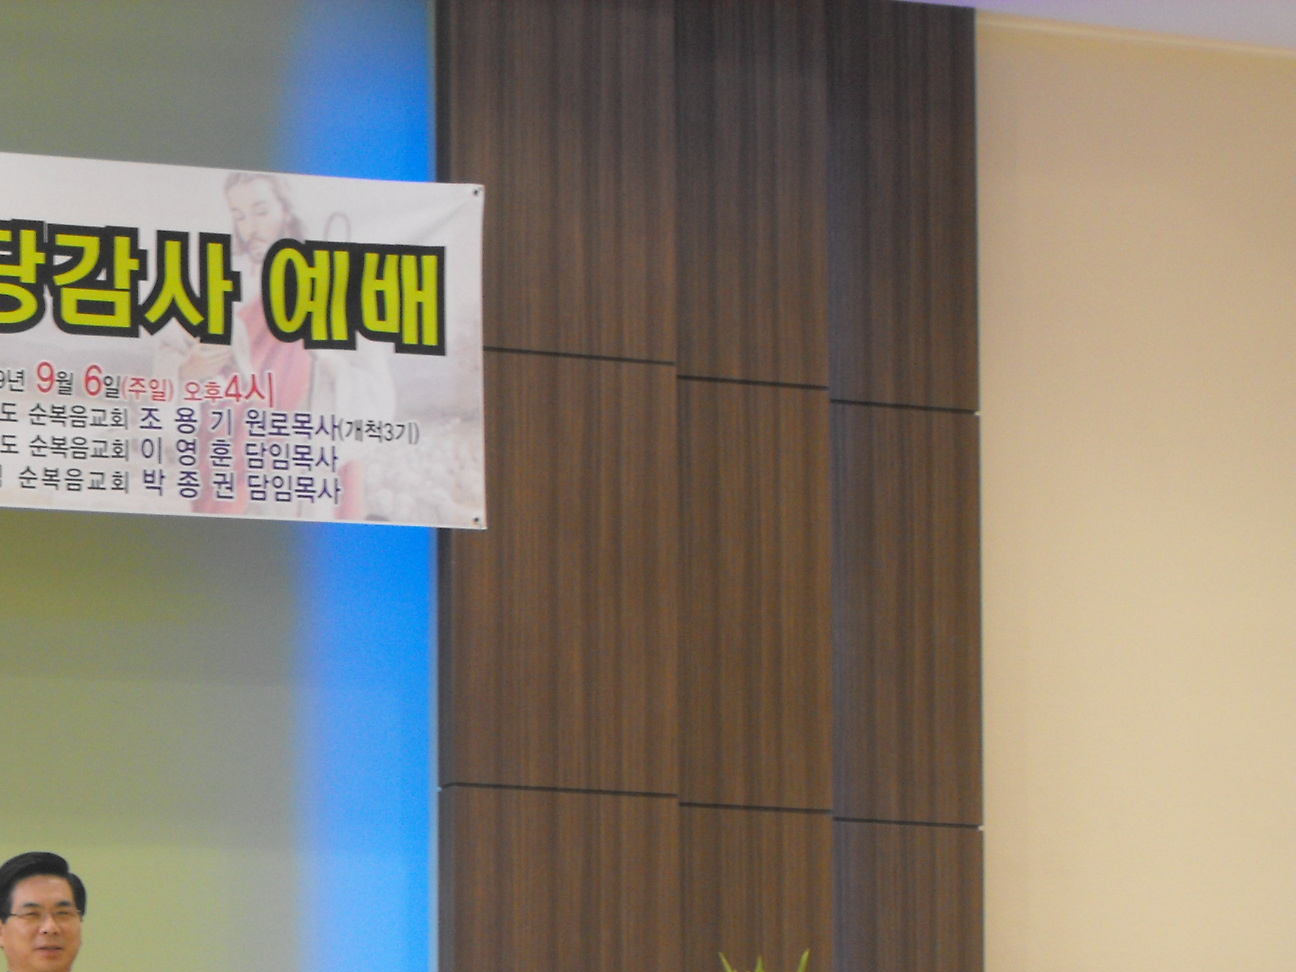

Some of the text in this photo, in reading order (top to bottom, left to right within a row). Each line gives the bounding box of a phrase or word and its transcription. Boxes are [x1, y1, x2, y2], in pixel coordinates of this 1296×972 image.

[265, 242, 444, 355] 예배
[36, 361, 73, 396] 9월
[183, 373, 275, 407] 오후4시
[29, 403, 128, 430] 순복음교회
[29, 435, 129, 462] 순복음교회
[245, 442, 338, 472] 담임목사
[18, 466, 129, 493] 순복음교회
[246, 474, 341, 504] 담임목사
